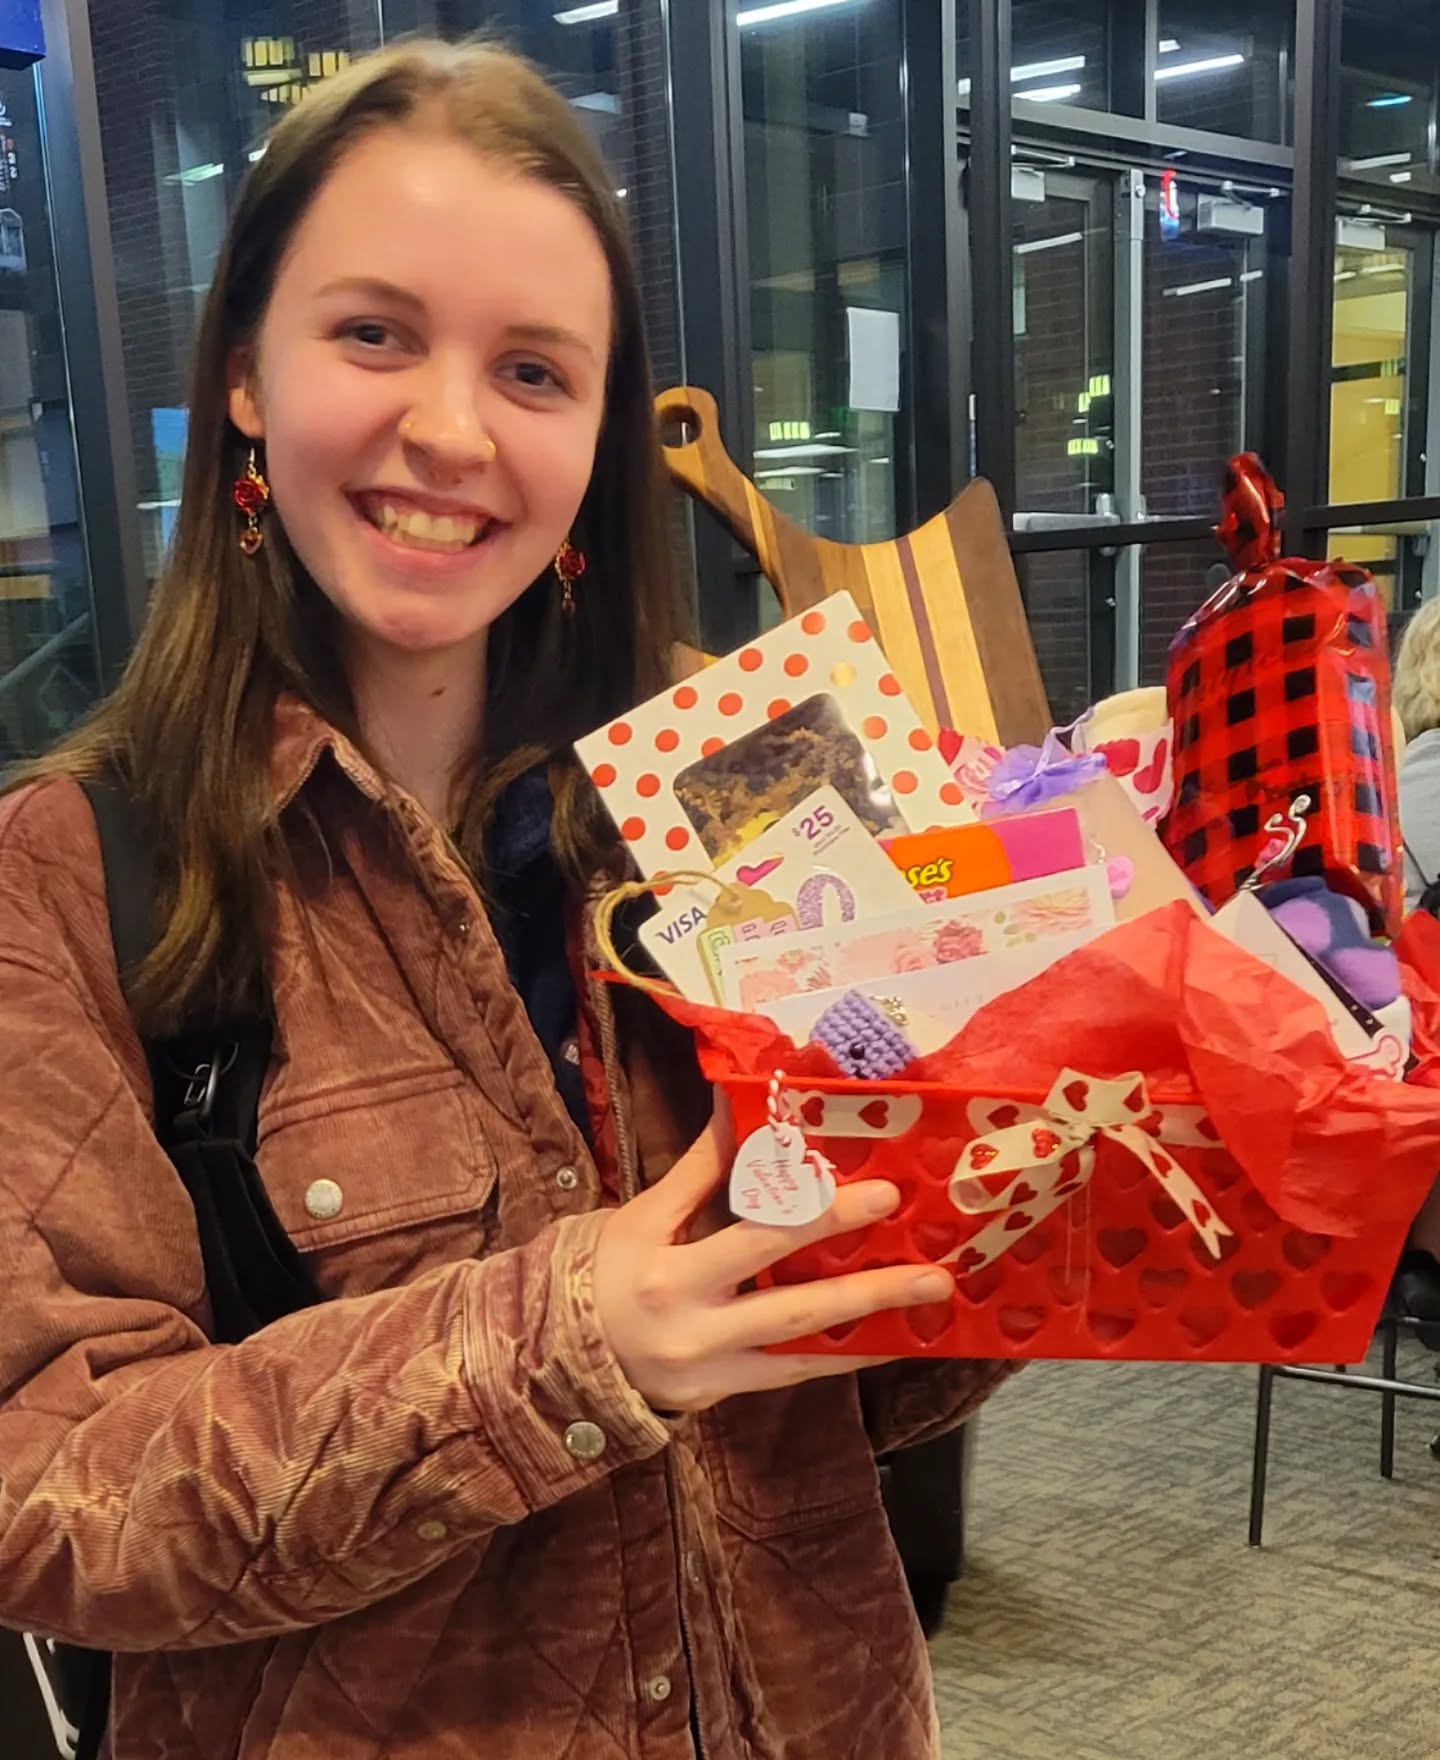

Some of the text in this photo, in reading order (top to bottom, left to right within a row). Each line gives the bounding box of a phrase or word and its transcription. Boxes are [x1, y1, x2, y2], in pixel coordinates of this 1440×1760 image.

[791, 803, 835, 841] $25
[899, 856, 954, 888] se's
[655, 905, 708, 945] VISA
